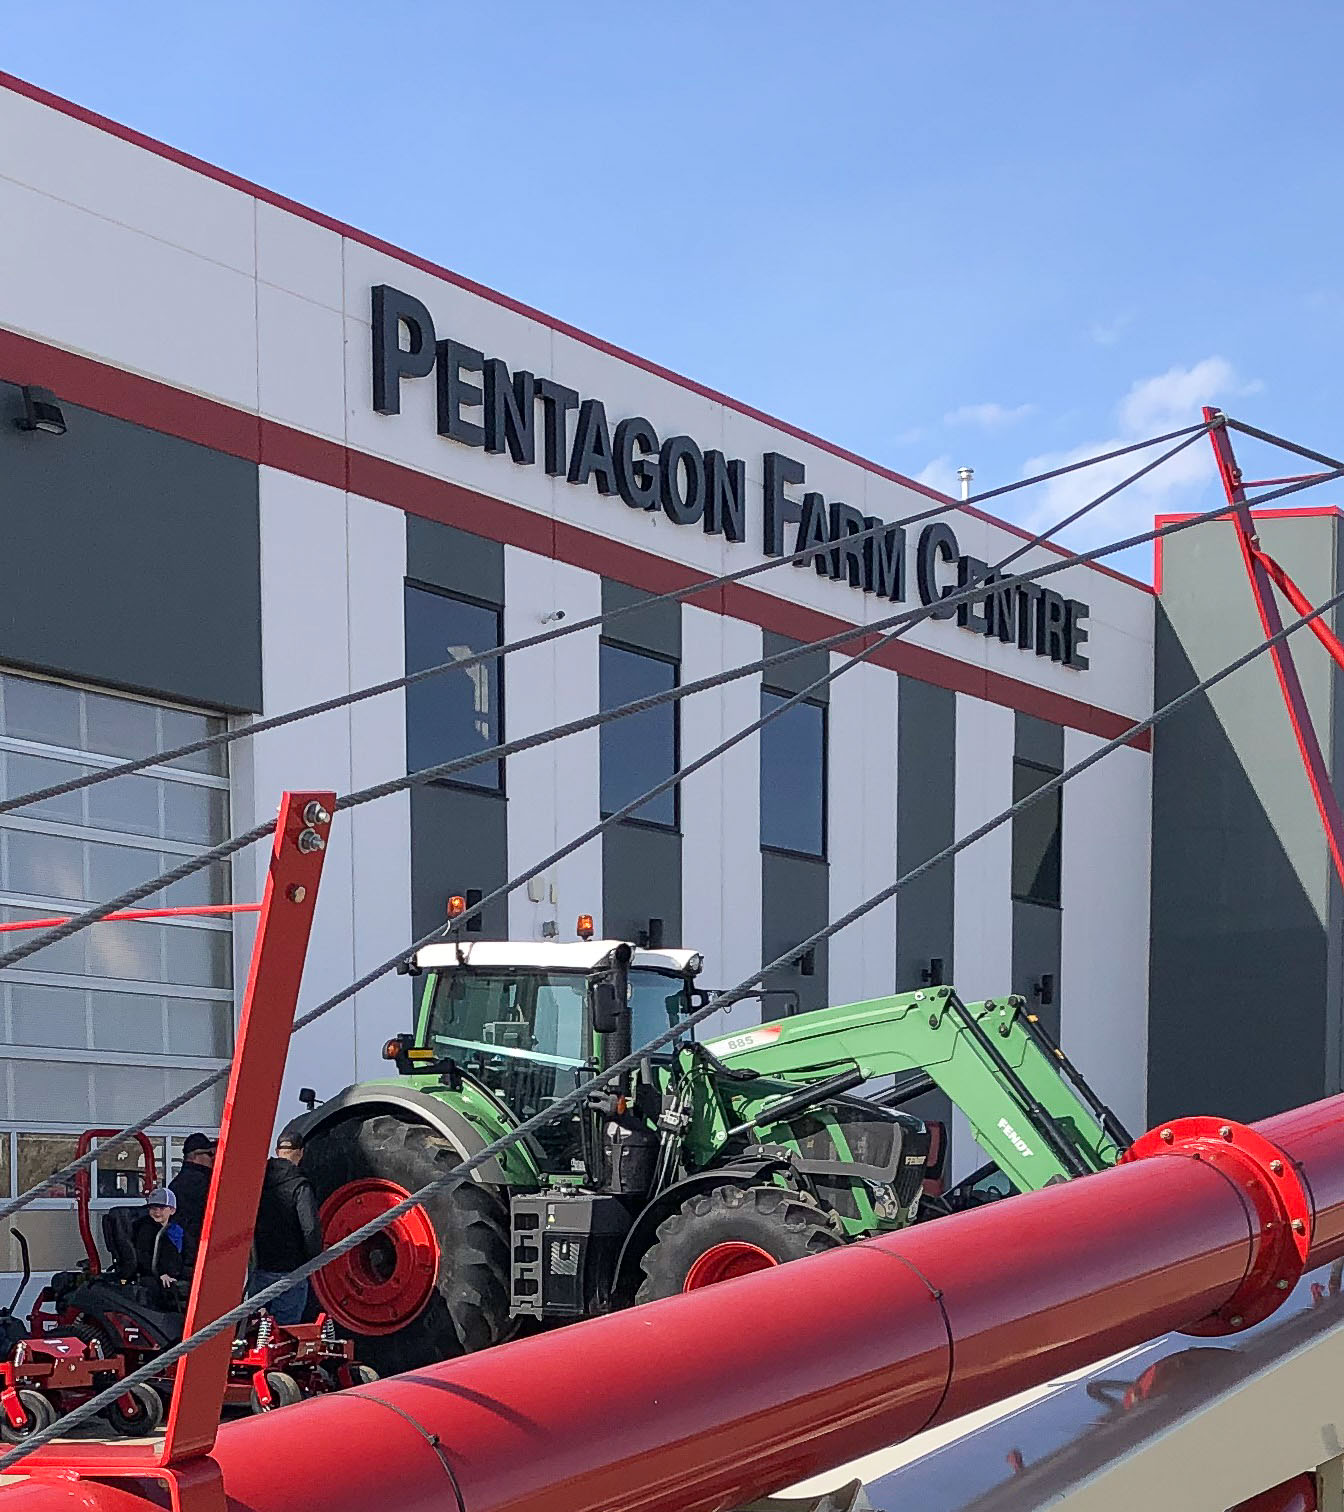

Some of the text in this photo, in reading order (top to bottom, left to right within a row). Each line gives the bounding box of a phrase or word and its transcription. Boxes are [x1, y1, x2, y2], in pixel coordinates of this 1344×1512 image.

[370, 283, 1090, 672] PENTAGON FARM CENTRE
[727, 1035, 754, 1050] 885
[996, 1116, 1034, 1158] FENDT
